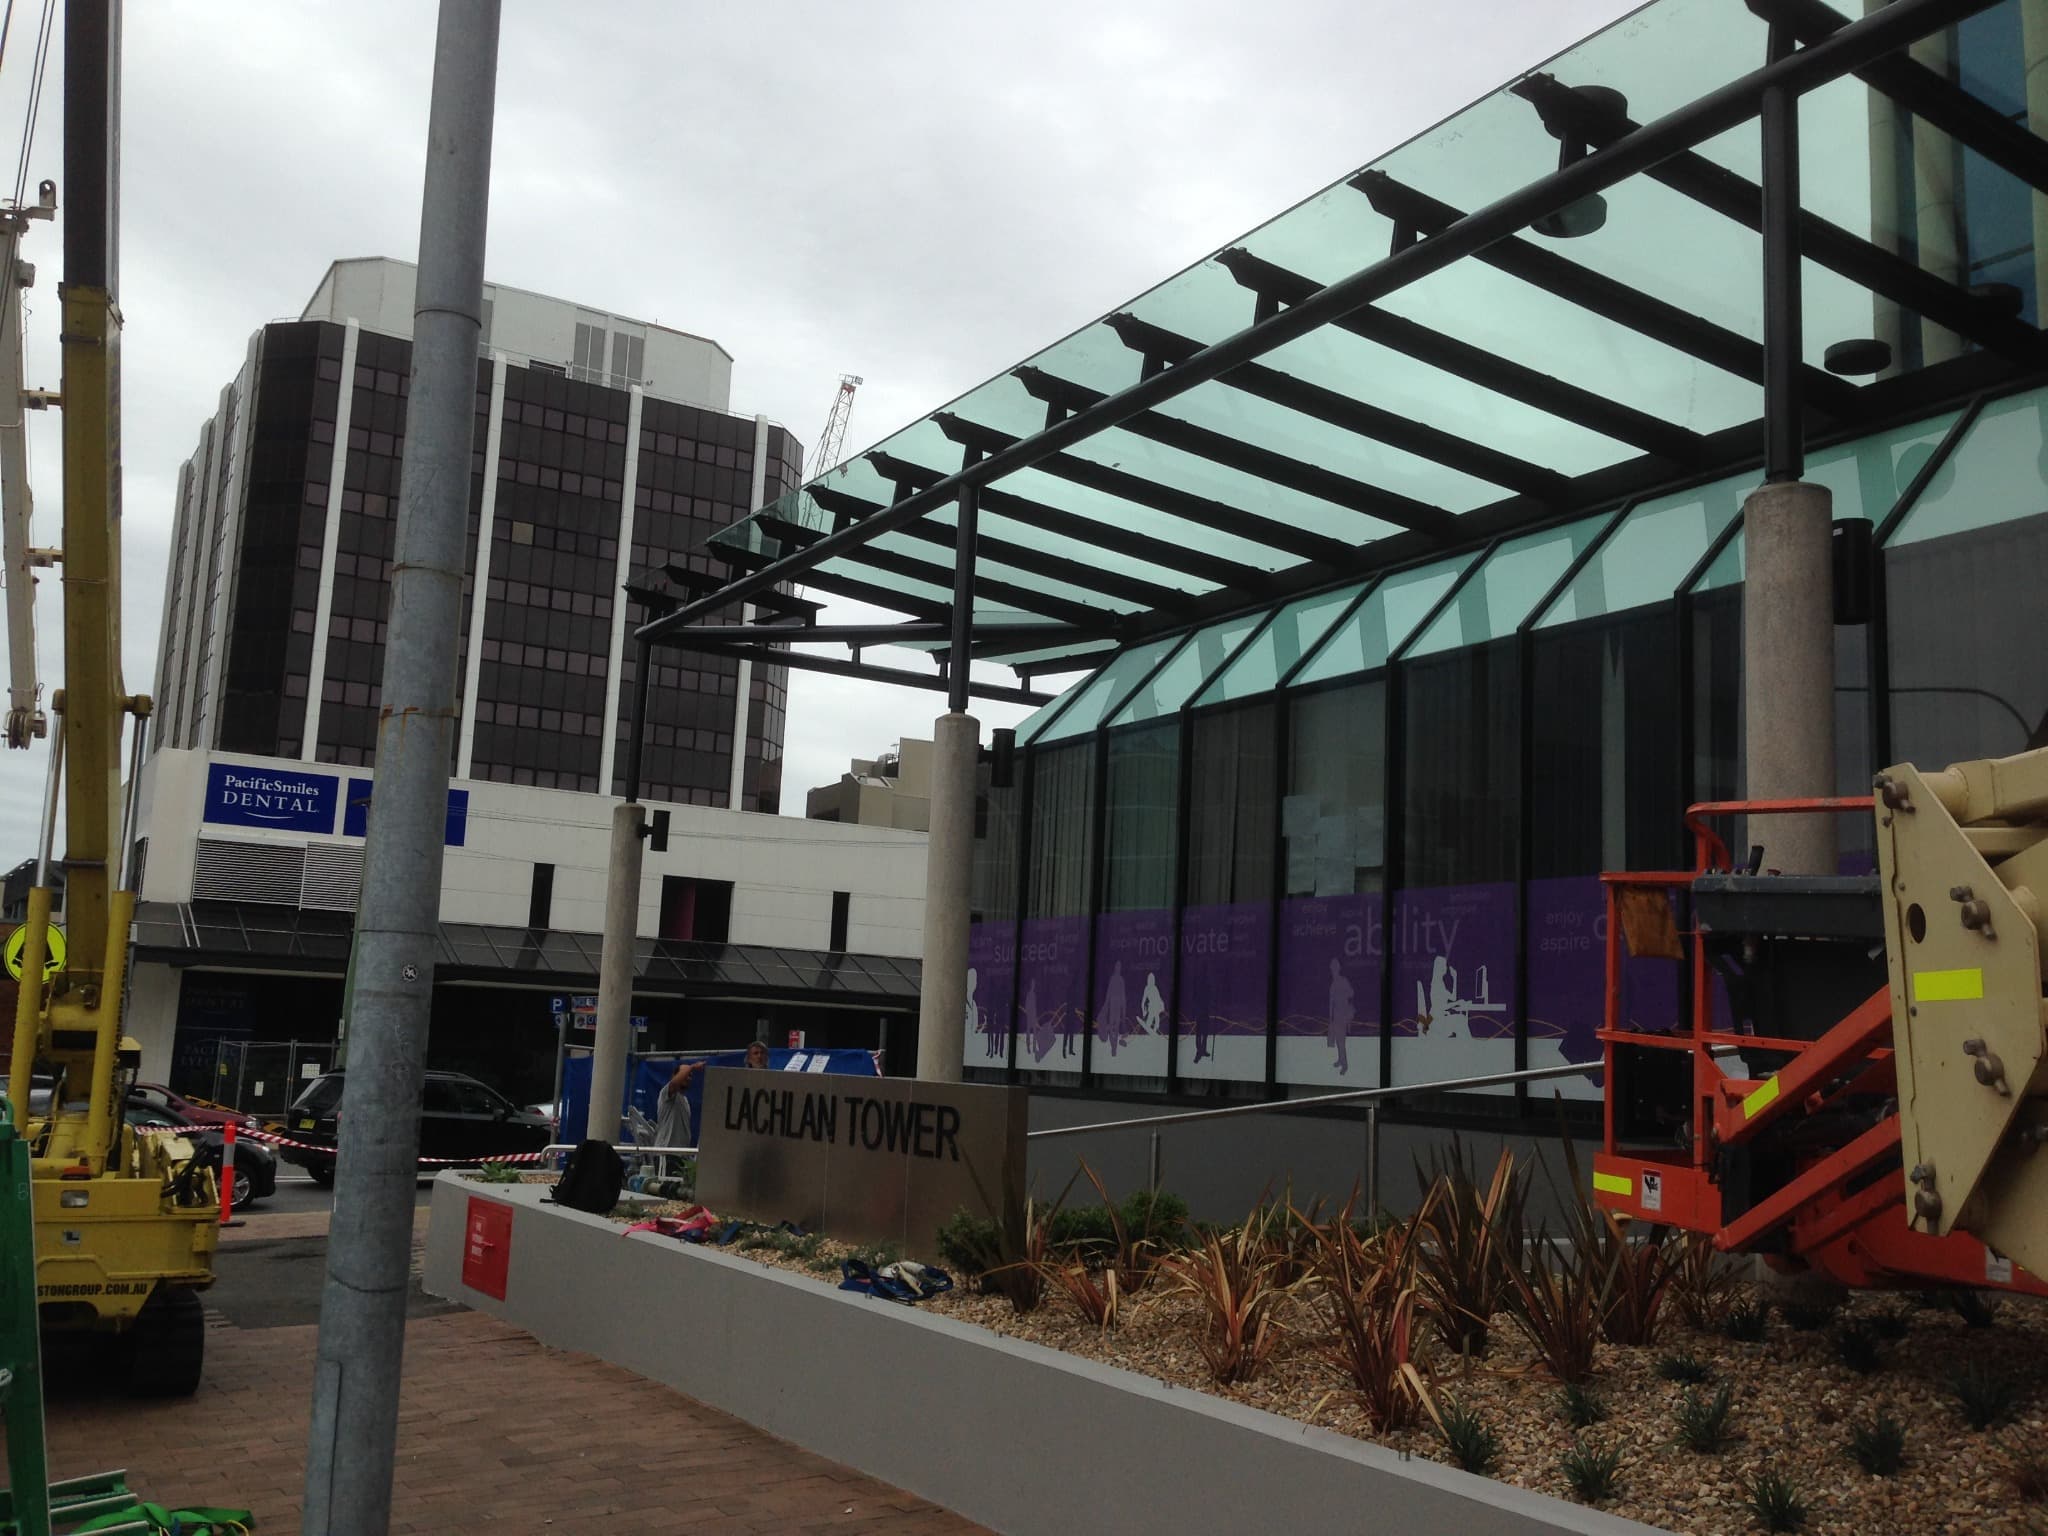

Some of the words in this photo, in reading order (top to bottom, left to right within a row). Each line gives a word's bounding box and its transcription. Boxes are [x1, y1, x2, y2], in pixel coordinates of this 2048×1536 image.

[224, 774, 320, 796] PacificSmiles
[222, 790, 318, 814] DENTAL
[1543, 904, 1585, 928] enjoy
[1344, 903, 1461, 959] ability
[1539, 930, 1591, 956] aspire
[553, 998, 564, 1014] P
[725, 1085, 837, 1144] LACHLAN
[843, 1096, 962, 1162] TOWER
